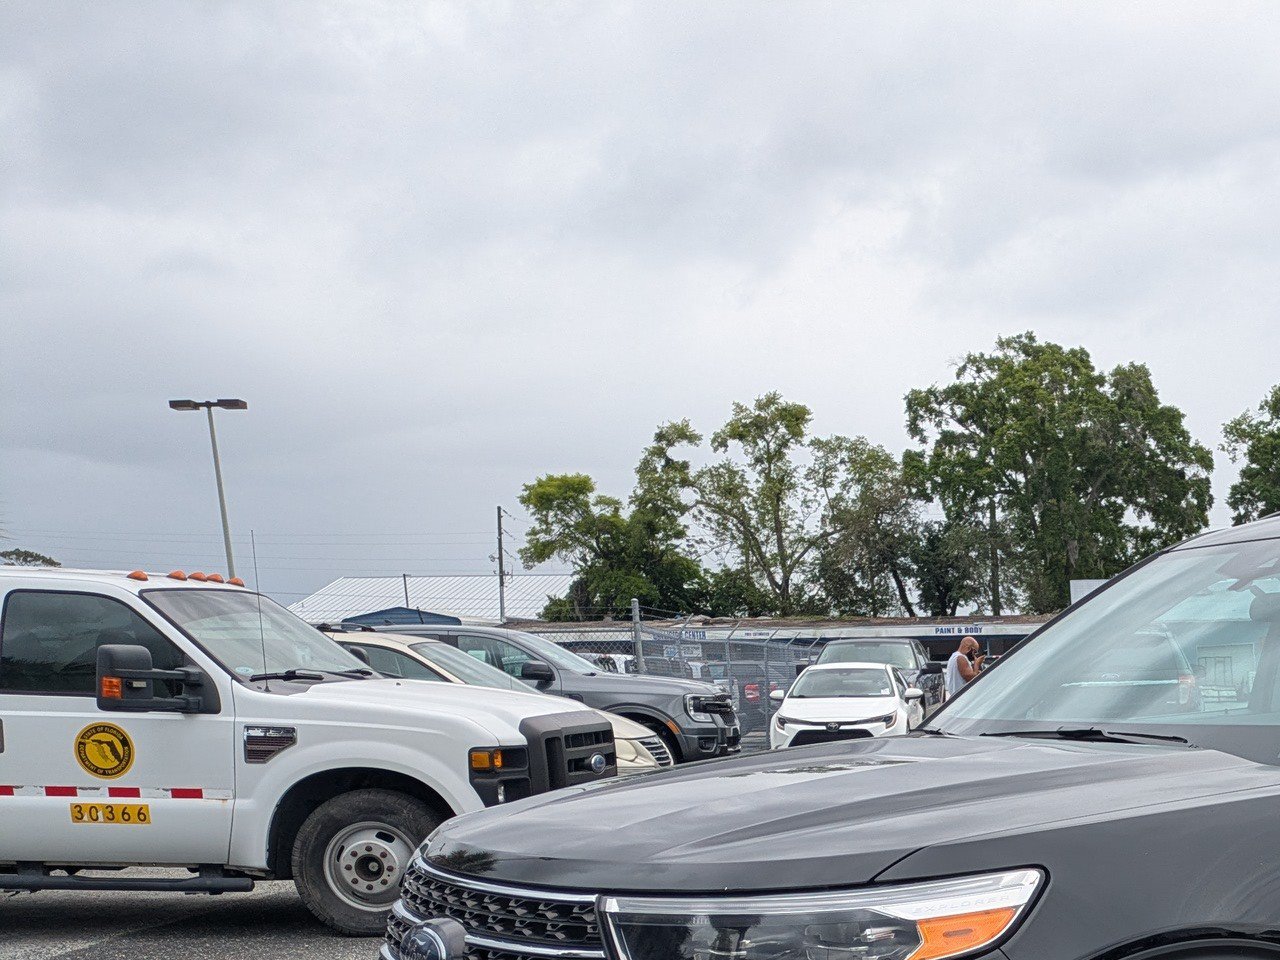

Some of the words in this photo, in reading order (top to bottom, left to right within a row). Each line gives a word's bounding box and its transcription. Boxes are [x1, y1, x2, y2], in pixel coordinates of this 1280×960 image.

[684, 630, 706, 640] CENTER
[83, 728, 97, 739] STATE
[104, 726, 124, 740] FLORIDA
[74, 805, 147, 822] 30366
[912, 895, 1010, 914] EXPLORER
